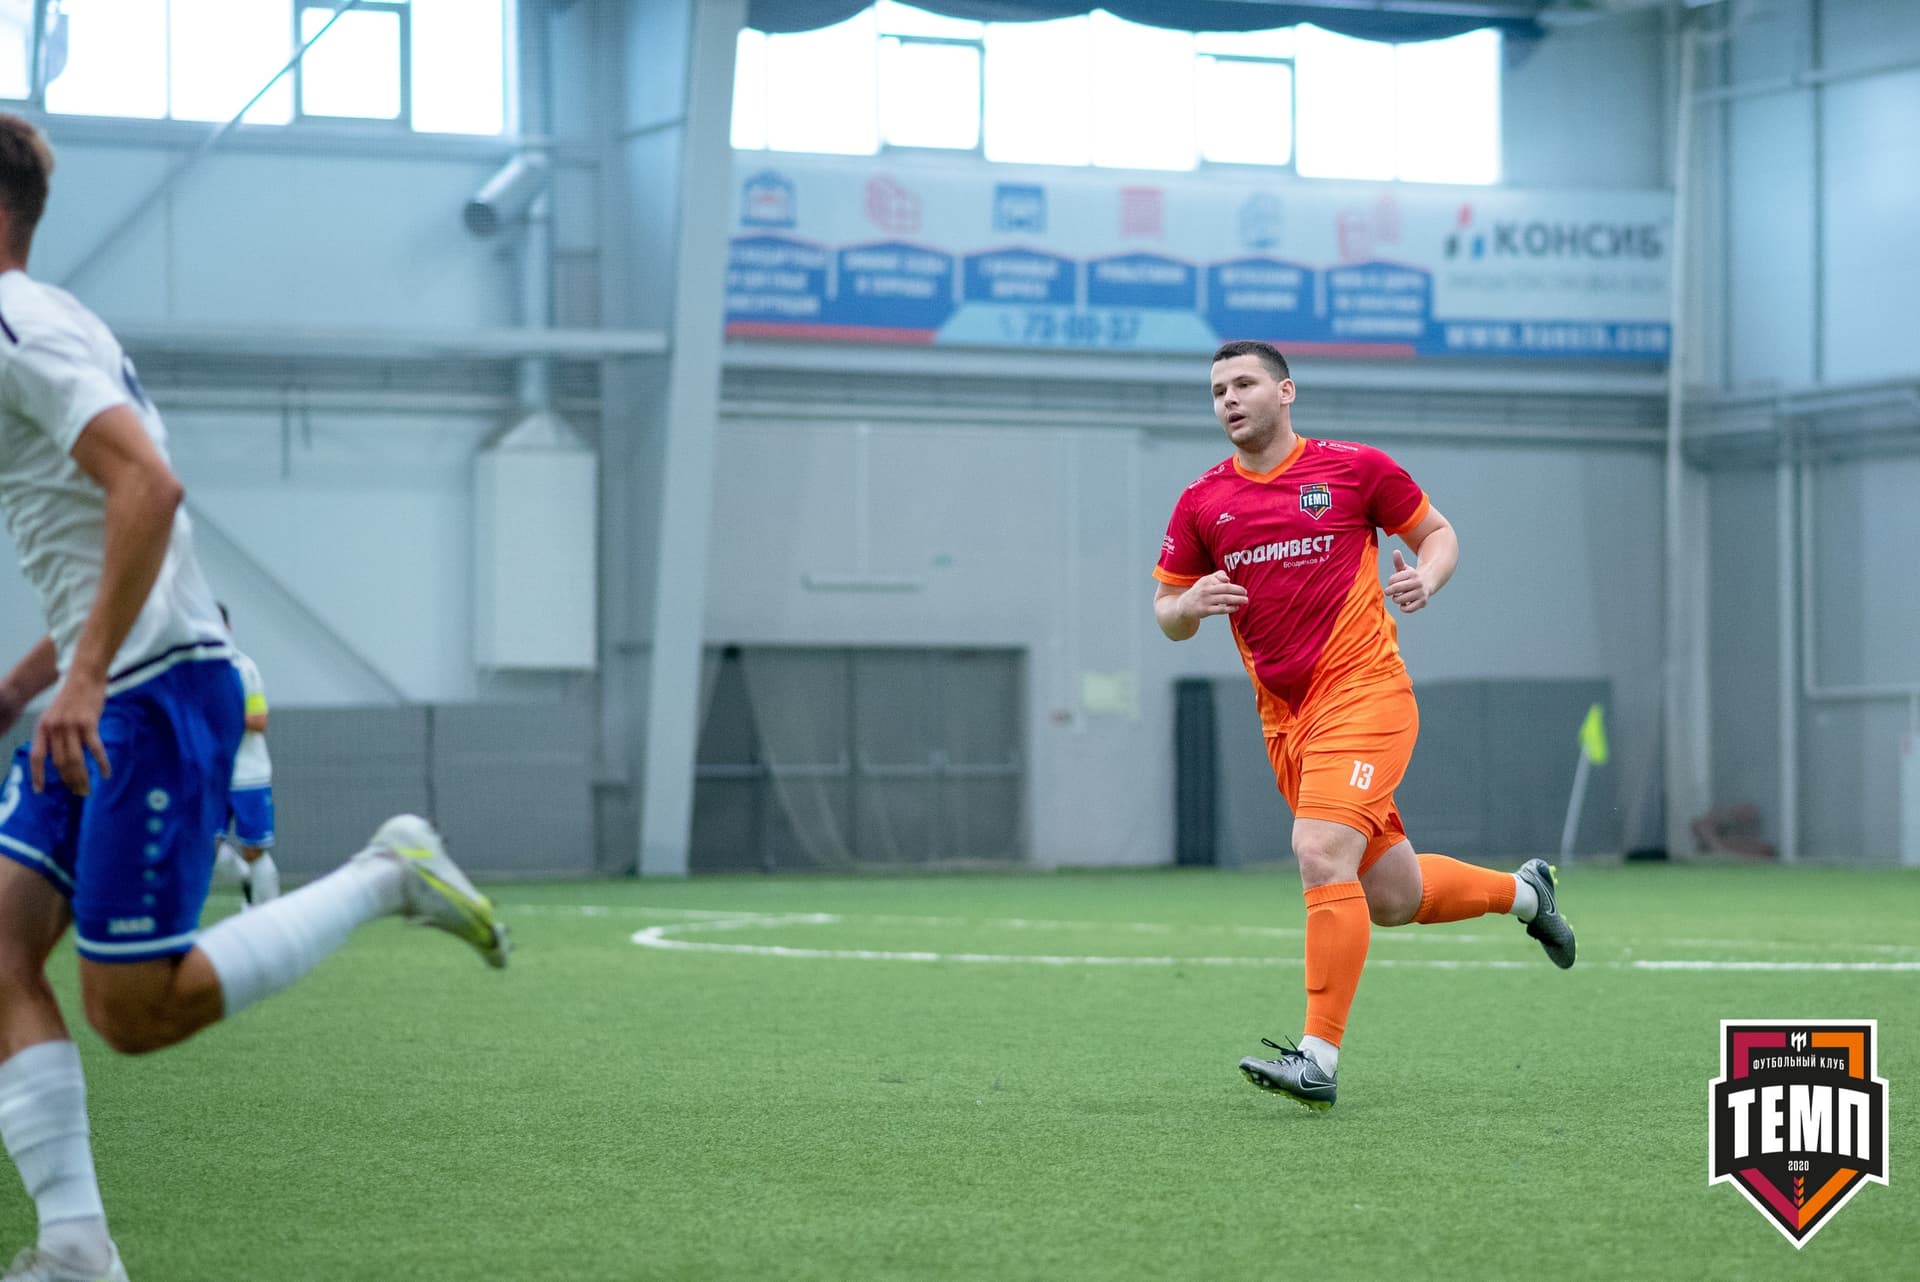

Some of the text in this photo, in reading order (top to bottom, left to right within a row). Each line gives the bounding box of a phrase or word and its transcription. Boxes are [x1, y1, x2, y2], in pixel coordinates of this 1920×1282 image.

[1493, 221, 1663, 260] КОНСИБ
[1302, 492, 1329, 508] ТЕМП
[1223, 534, 1335, 572] ПРОДИНВЕСТ
[1348, 759, 1375, 790] 13
